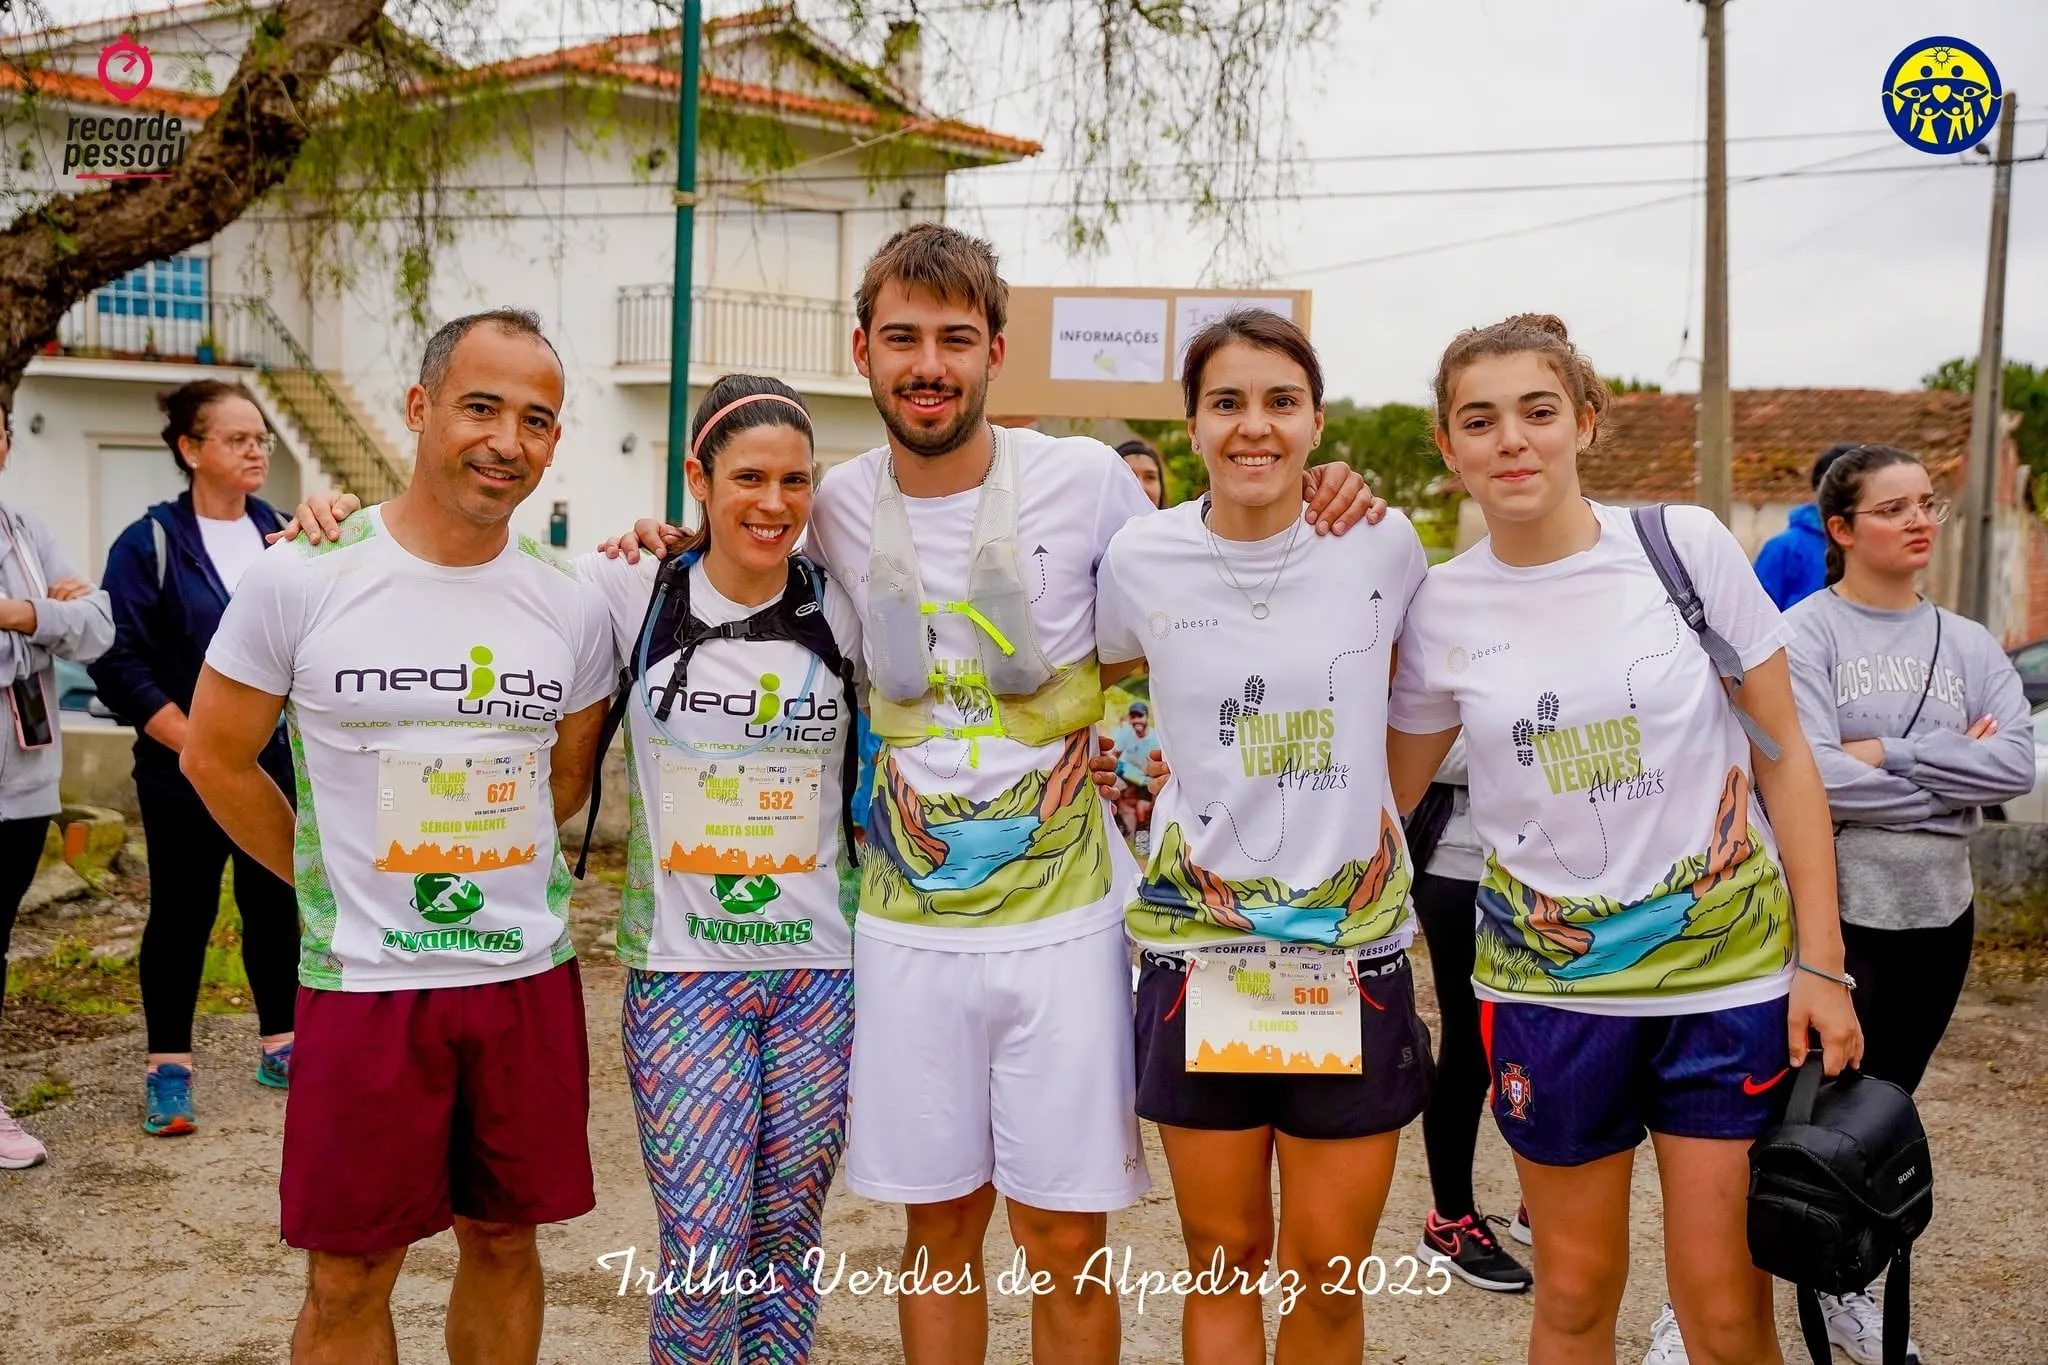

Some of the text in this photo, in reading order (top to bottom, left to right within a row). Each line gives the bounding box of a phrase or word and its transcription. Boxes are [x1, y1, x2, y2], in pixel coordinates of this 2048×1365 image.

[1059, 329, 1159, 346] INFORMAÇÕES
[1174, 617, 1219, 630] abesra
[1471, 641, 1511, 661] abesra
[1836, 653, 1966, 711] LOS ANGELES
[340, 719, 392, 729] produtos
[397, 718, 414, 727] de
[1234, 708, 1335, 746] TRILHOS
[1529, 715, 1641, 764] TRILHOS
[1240, 740, 1333, 778] VERDES
[1278, 752, 1351, 791] Alpedriz
[1542, 747, 1644, 795] VERDES
[1588, 758, 1665, 802] Alpedriz
[487, 781, 517, 804] 627
[1311, 773, 1350, 791] 2025
[1627, 778, 1665, 801] 2025
[759, 791, 795, 810] 532
[420, 817, 507, 834] SÉRGIO VALENTE
[704, 823, 775, 837] MARTA SILVA
[383, 926, 524, 953] TWOPIKAS
[685, 912, 814, 946] TWOPIKAS
[1294, 987, 1329, 1005] 510
[1259, 1020, 1299, 1033] FLORES
[1898, 1166, 1916, 1185] SONY
